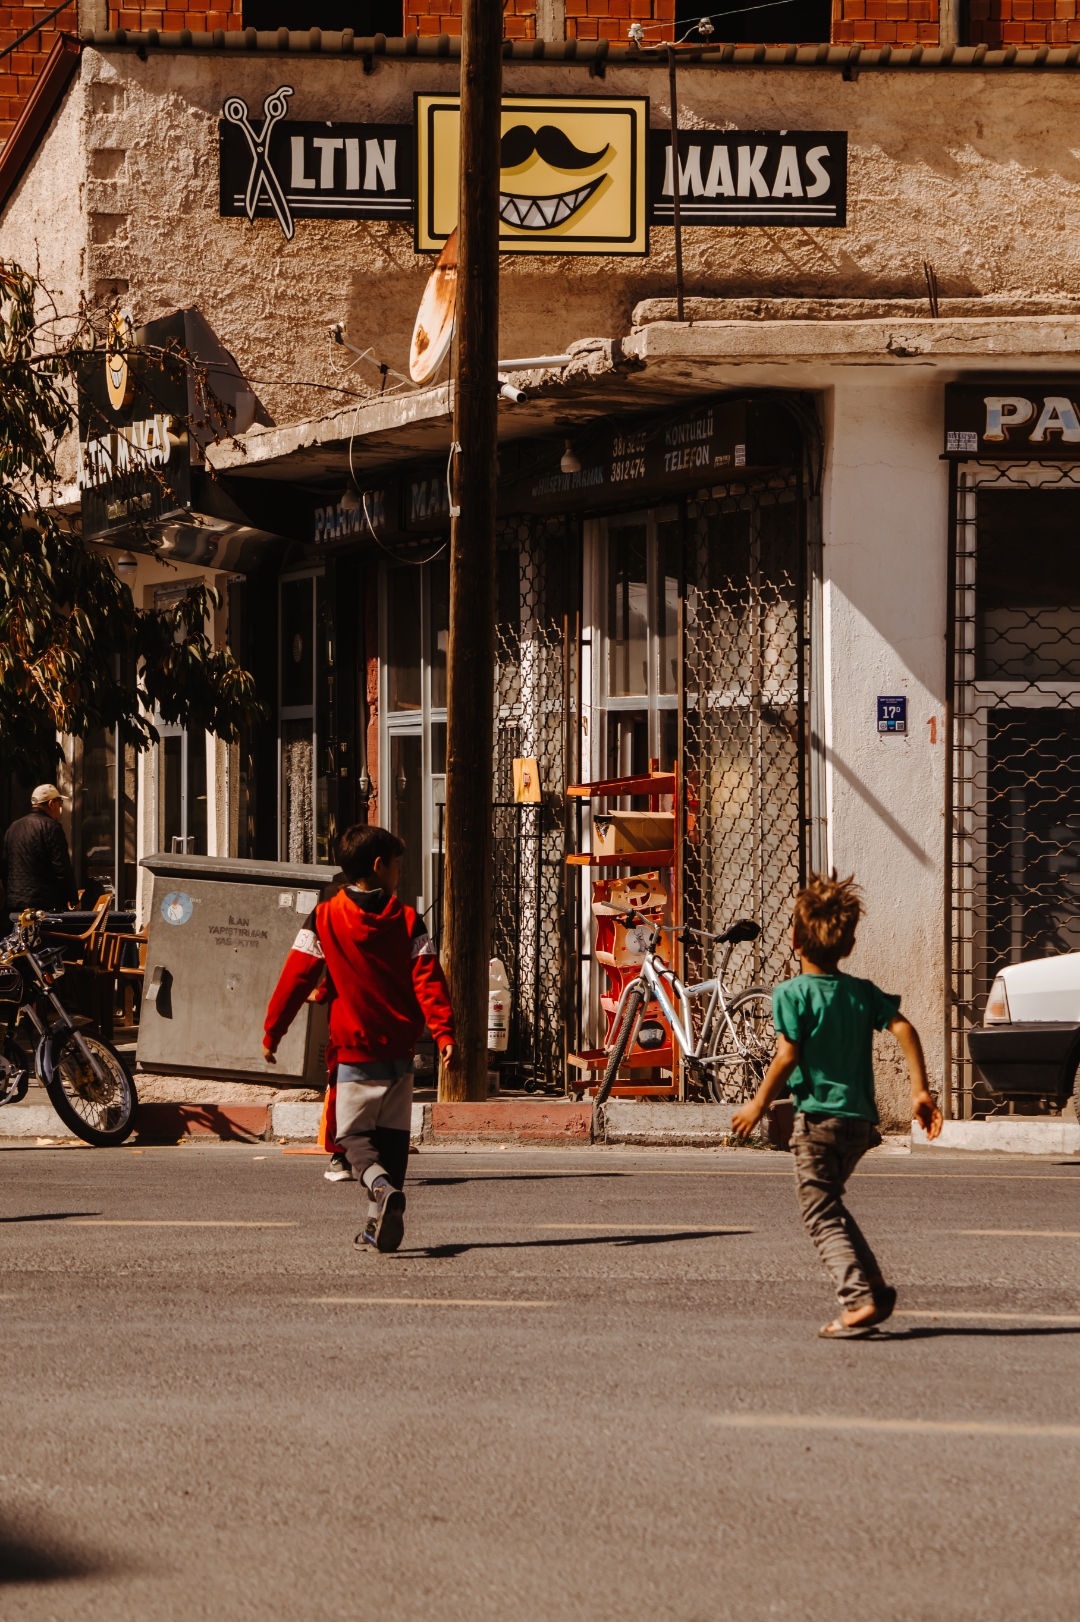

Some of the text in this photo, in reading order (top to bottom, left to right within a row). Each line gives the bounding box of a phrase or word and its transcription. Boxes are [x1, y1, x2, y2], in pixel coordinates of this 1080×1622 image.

[662, 145, 831, 198] MAKAS
[983, 396, 1080, 442] PA
[610, 458, 646, 482] 3812474
[664, 444, 710, 472] TELEFON
[571, 465, 604, 489] PARMAK
